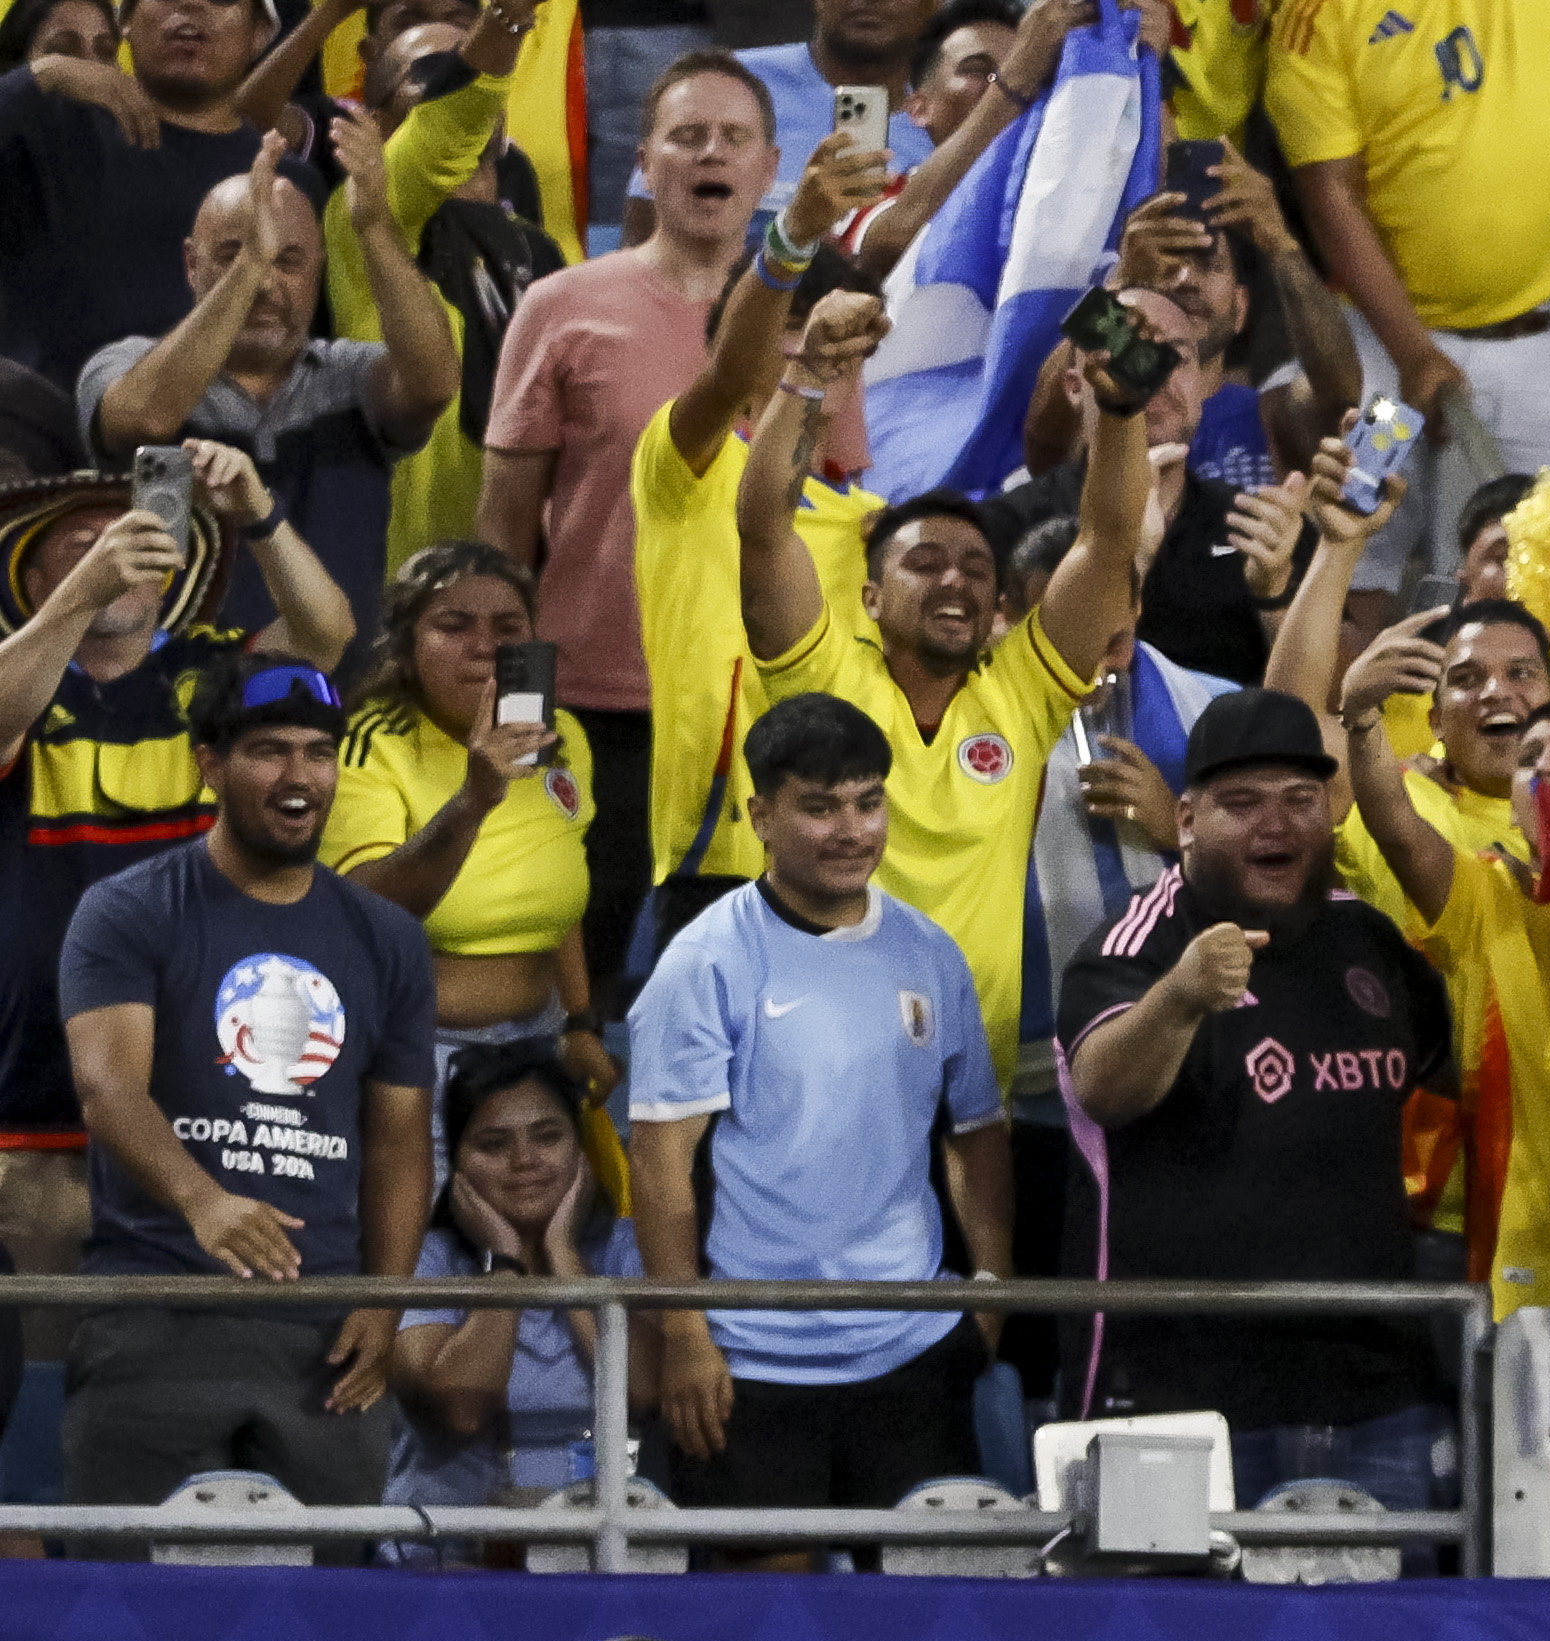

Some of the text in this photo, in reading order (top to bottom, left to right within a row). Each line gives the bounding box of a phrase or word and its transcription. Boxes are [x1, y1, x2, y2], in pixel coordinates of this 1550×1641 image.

[1309, 1048, 1407, 1091] XBTO
[173, 1117, 248, 1146] COPA
[221, 1147, 265, 1175] USA
